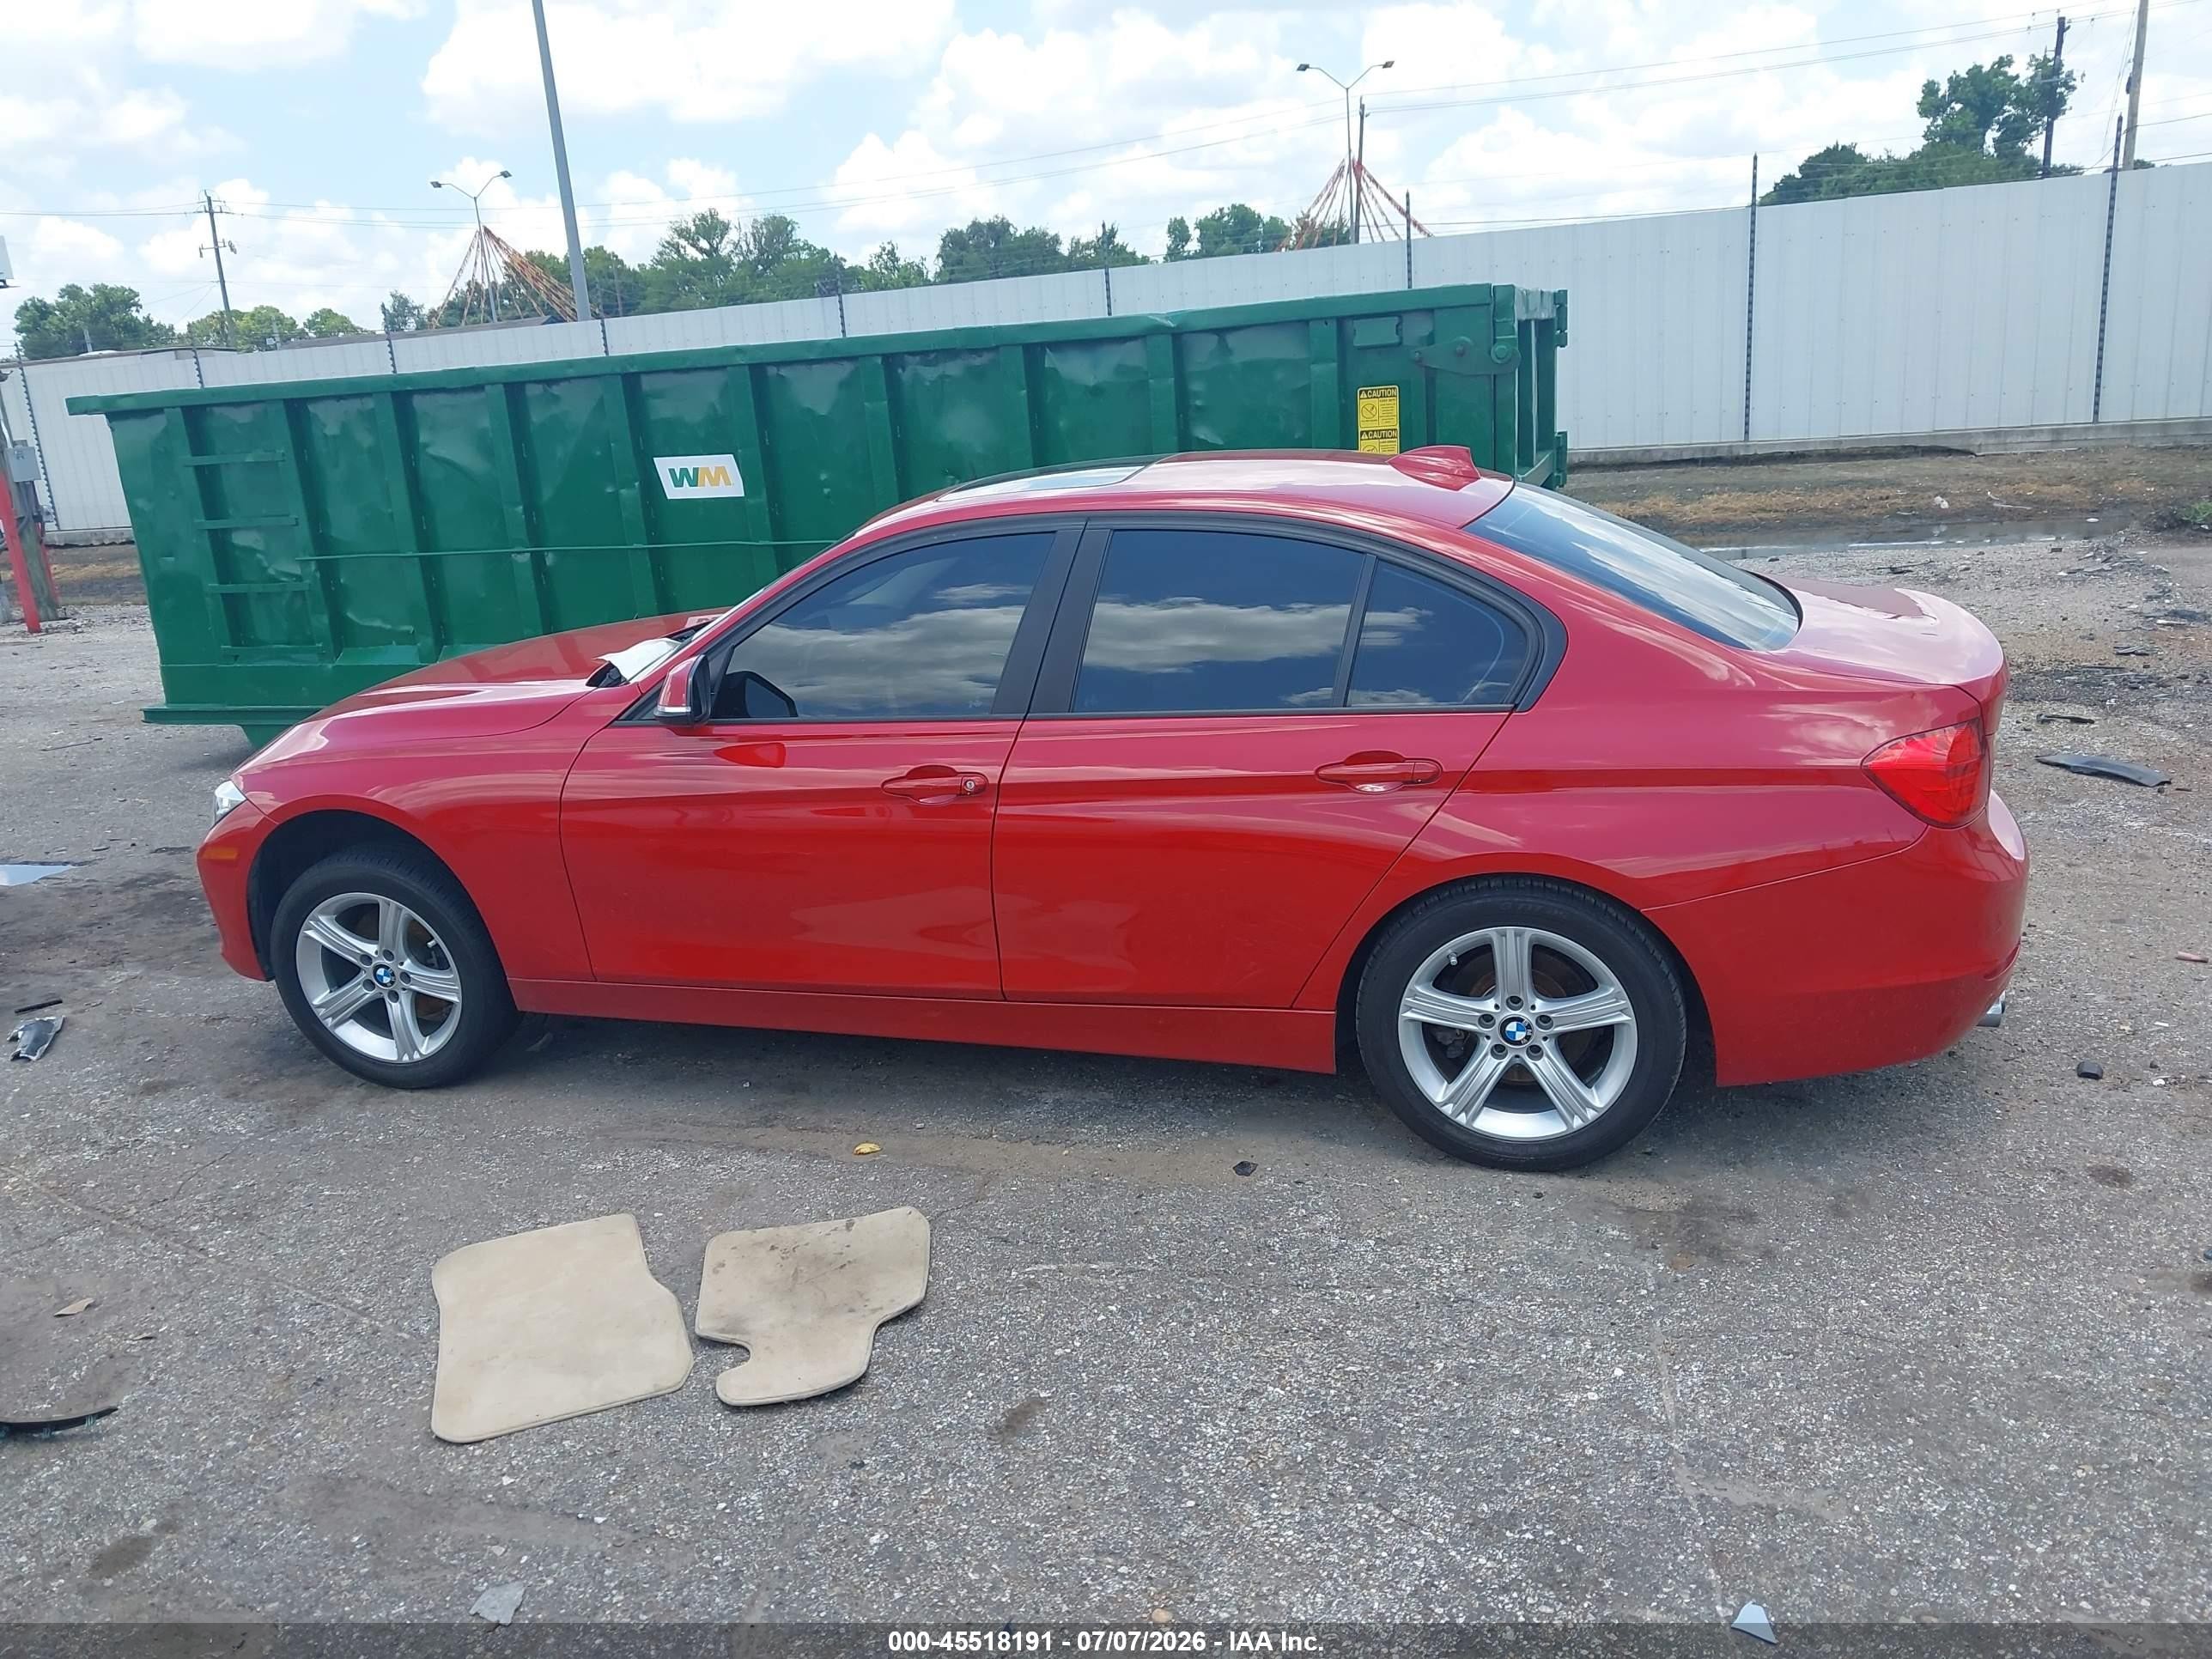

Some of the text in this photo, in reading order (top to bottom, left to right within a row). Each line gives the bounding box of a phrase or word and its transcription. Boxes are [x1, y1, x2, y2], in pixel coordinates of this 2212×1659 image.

[1367, 389, 1396, 398] CAUTION
[1368, 430, 1397, 439] CAUTION
[668, 466, 732, 488] WM
